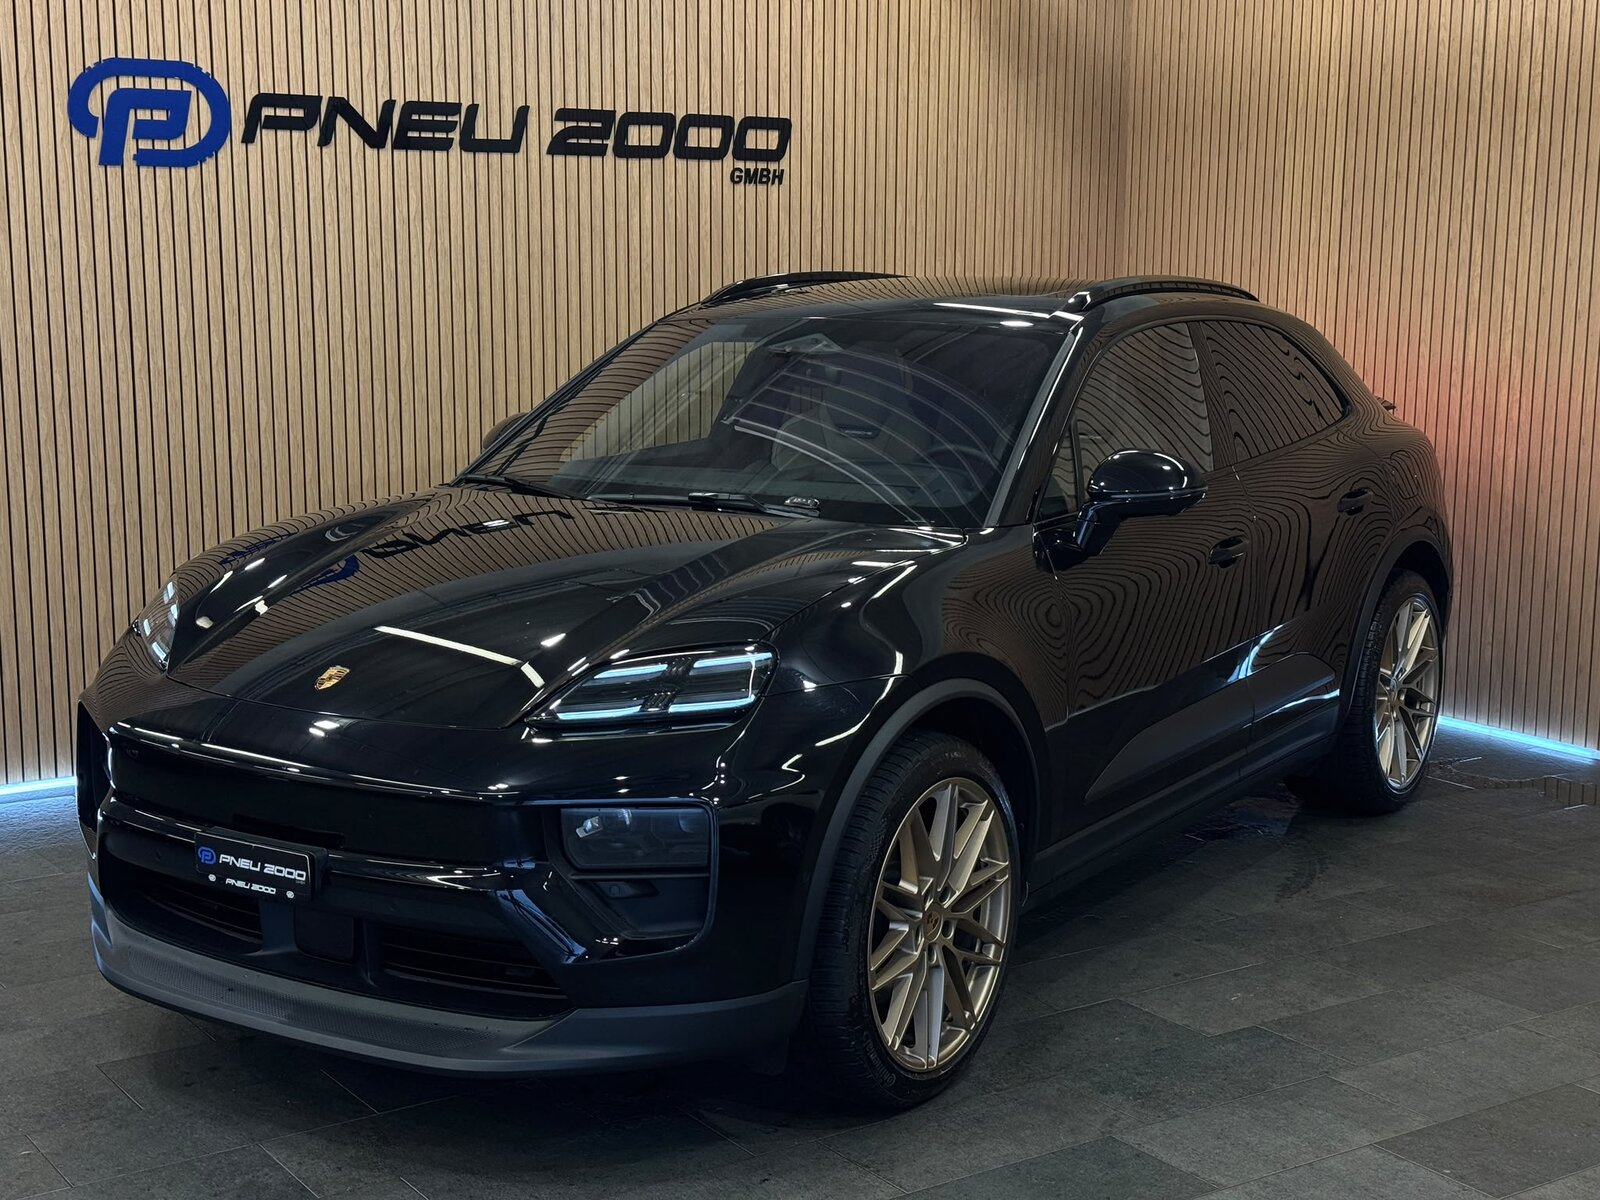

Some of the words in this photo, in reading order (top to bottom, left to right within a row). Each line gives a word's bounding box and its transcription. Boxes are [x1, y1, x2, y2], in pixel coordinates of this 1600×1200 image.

[241, 93, 530, 154] PNEU
[546, 108, 792, 162] 2000
[730, 167, 784, 186] GMBH
[219, 854, 261, 871] PNEU
[263, 863, 306, 880] 2000
[225, 878, 250, 889] PNEU
[251, 883, 276, 894] 2000
